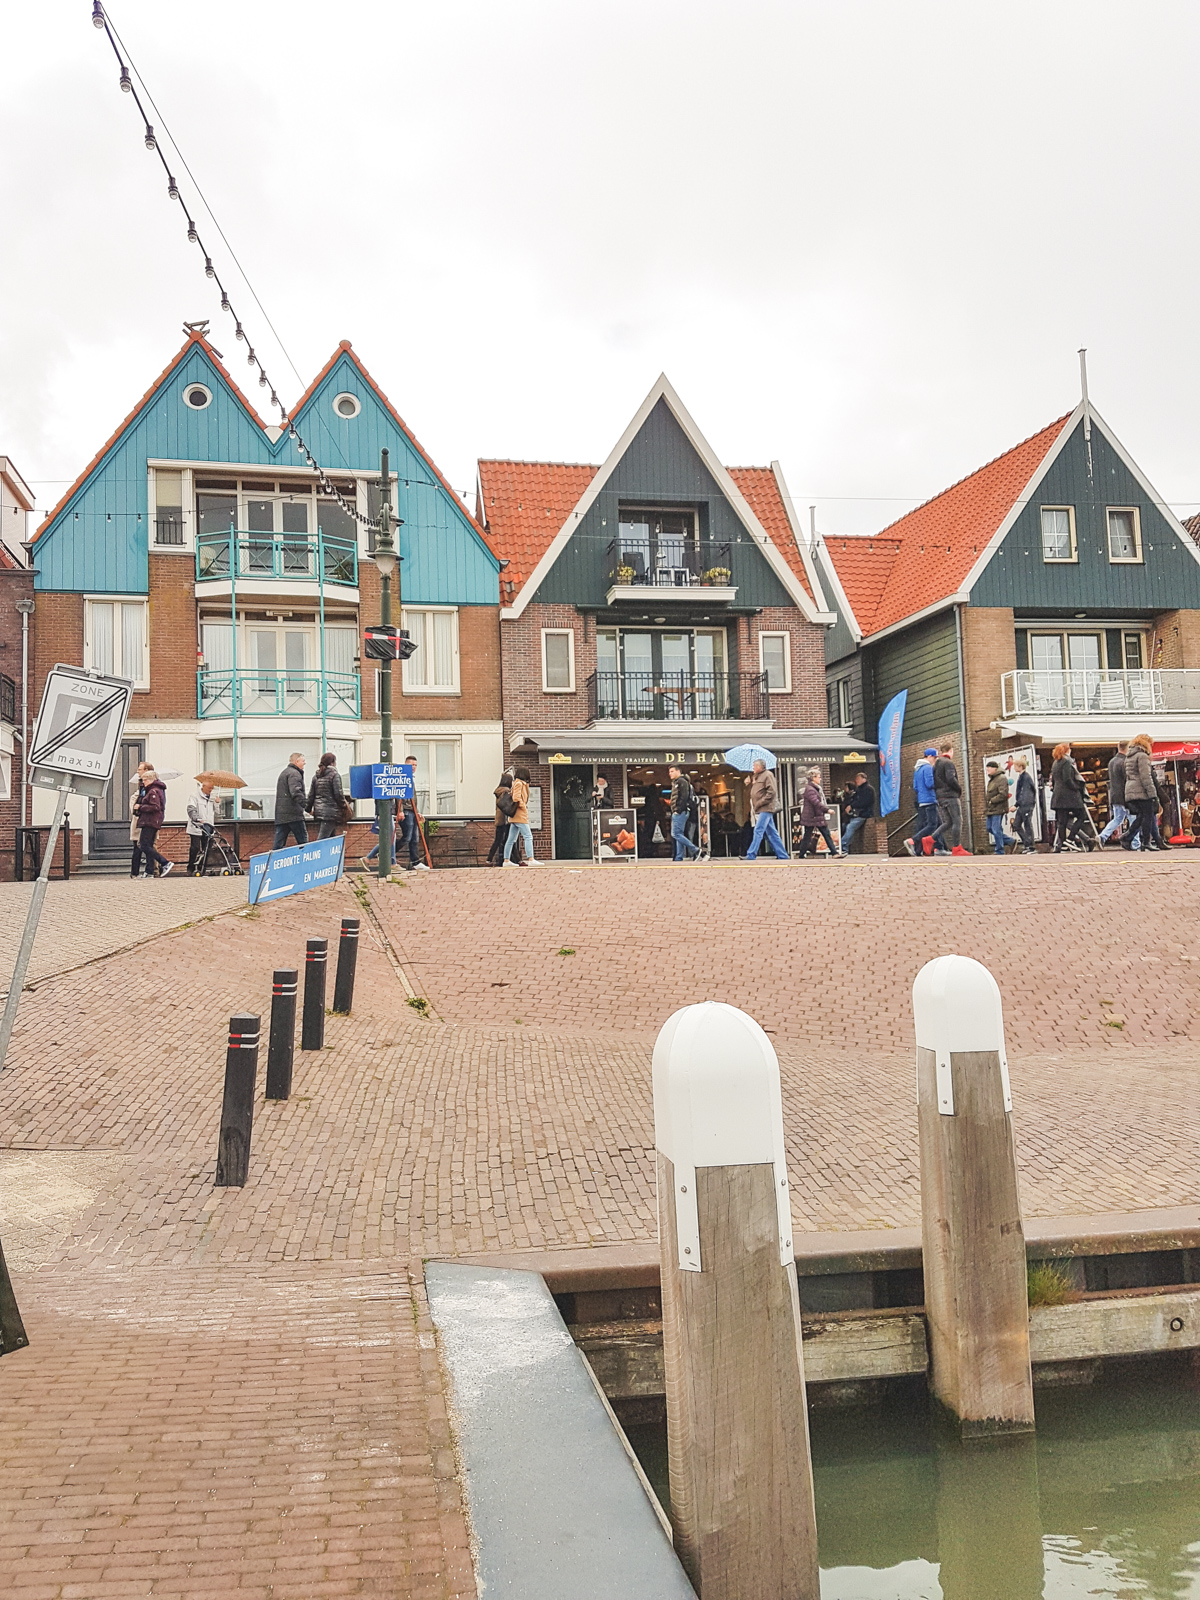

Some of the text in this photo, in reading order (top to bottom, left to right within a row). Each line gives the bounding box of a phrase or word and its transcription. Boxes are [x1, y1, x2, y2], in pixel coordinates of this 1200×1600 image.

[71, 683, 105, 698] ZONE
[57, 754, 102, 770] max 3h
[665, 752, 686, 763] DE
[383, 765, 403, 775] Fijne
[375, 775, 412, 786] Gerookte
[381, 787, 406, 798] Paling
[273, 854, 301, 870] GEROOKTE
[302, 849, 321, 863] PALING
[303, 872, 312, 883] EN
